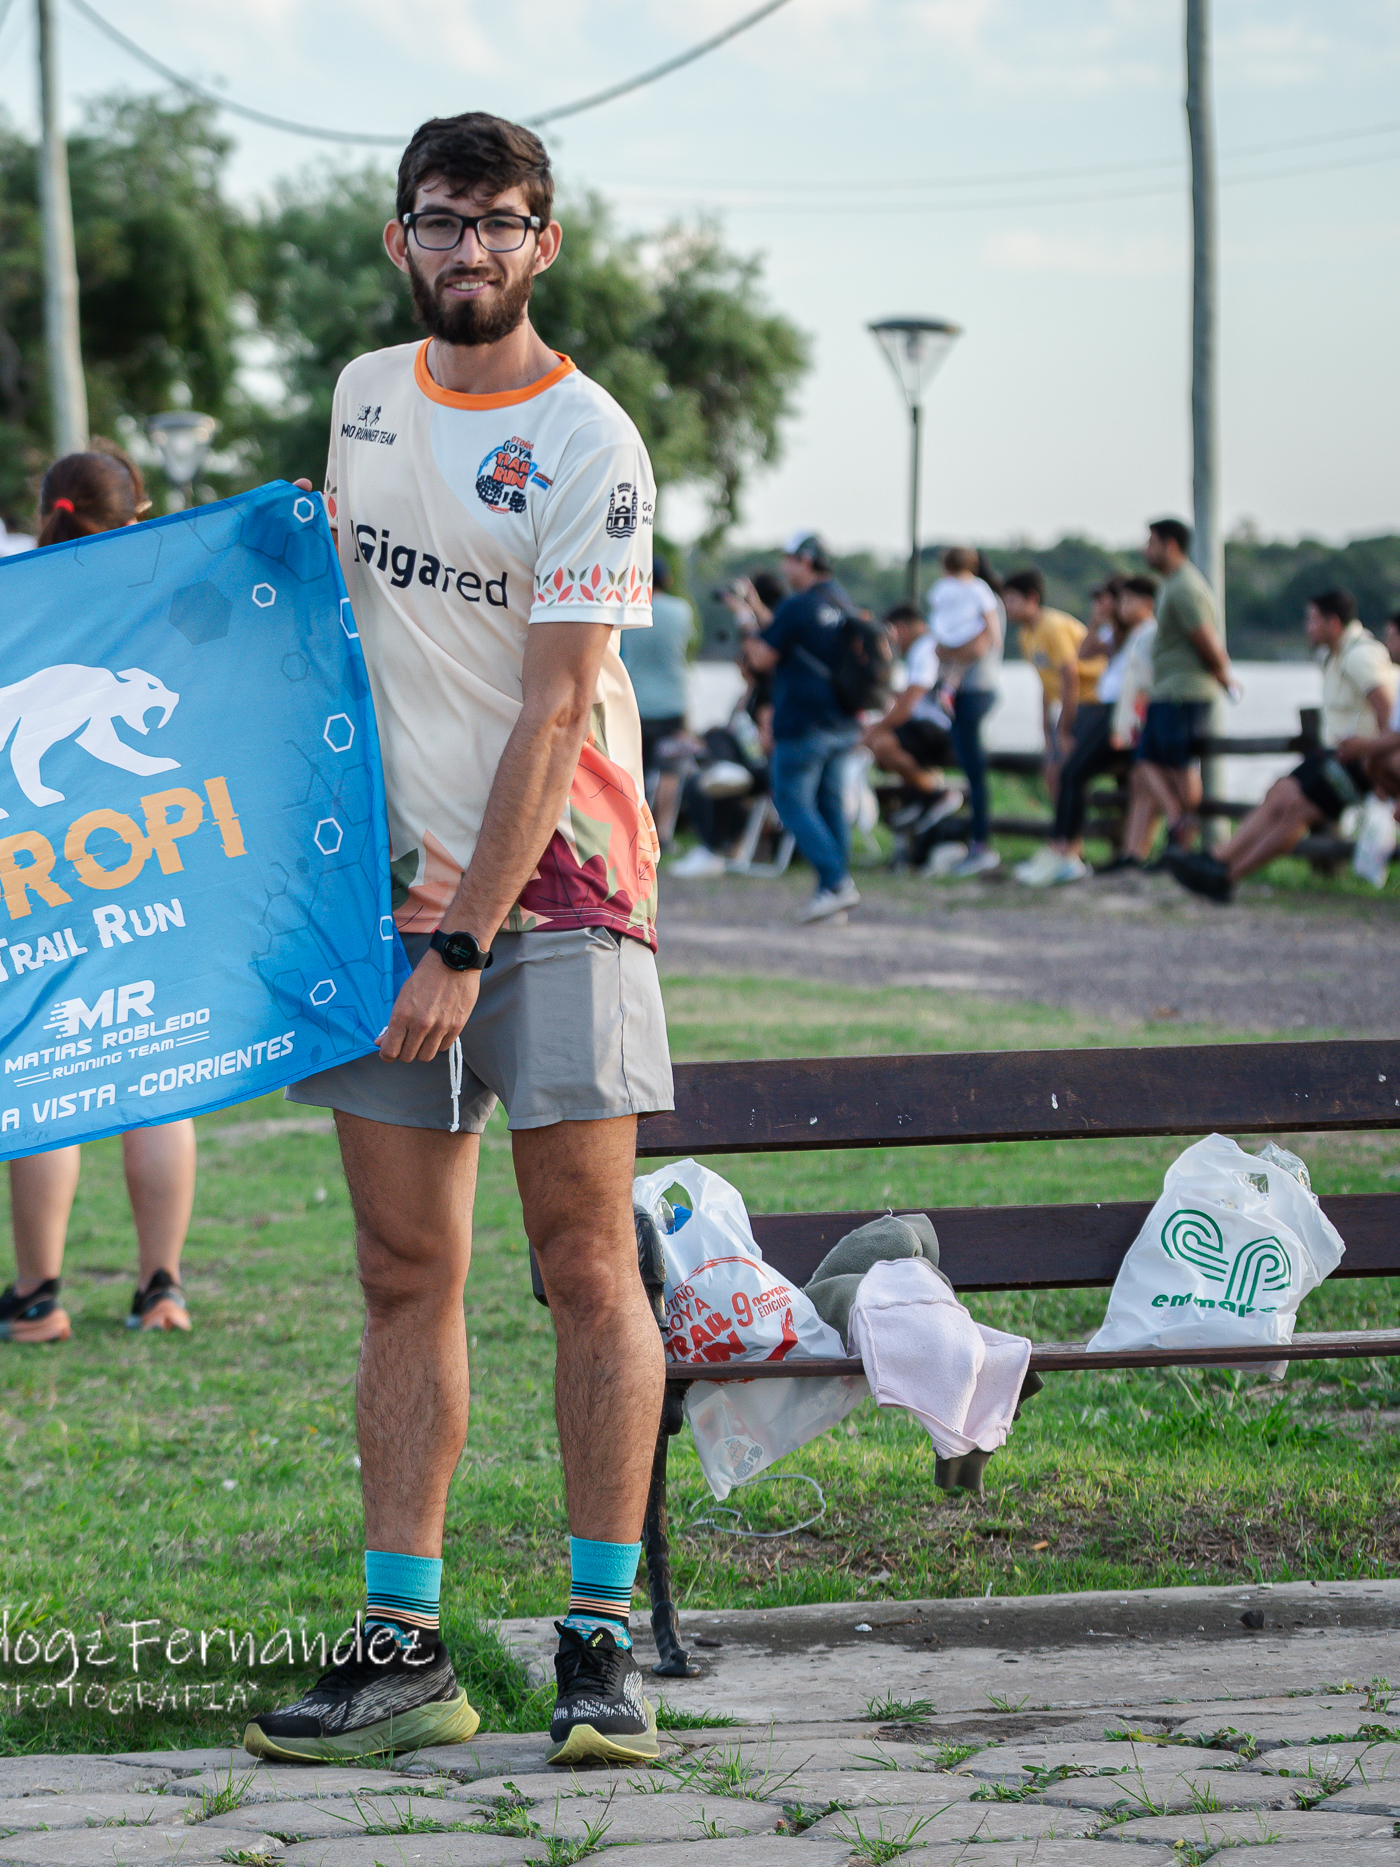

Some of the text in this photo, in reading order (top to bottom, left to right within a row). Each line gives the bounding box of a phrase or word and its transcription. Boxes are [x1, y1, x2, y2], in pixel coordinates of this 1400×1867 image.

[341, 423, 397, 445] MO RUNNER TEAM
[502, 440, 532, 460] GOYA
[492, 465, 528, 490] RUN
[350, 519, 508, 609] Gigared
[92, 898, 186, 948] RUN
[48, 979, 155, 1039] MR
[4, 1007, 210, 1074] MATIAS ROBLEDO
[52, 1038, 175, 1079] RUNNING TEAM
[32, 1083, 116, 1121] VISTA
[731, 1291, 792, 1328] 9 EDICIÓN
